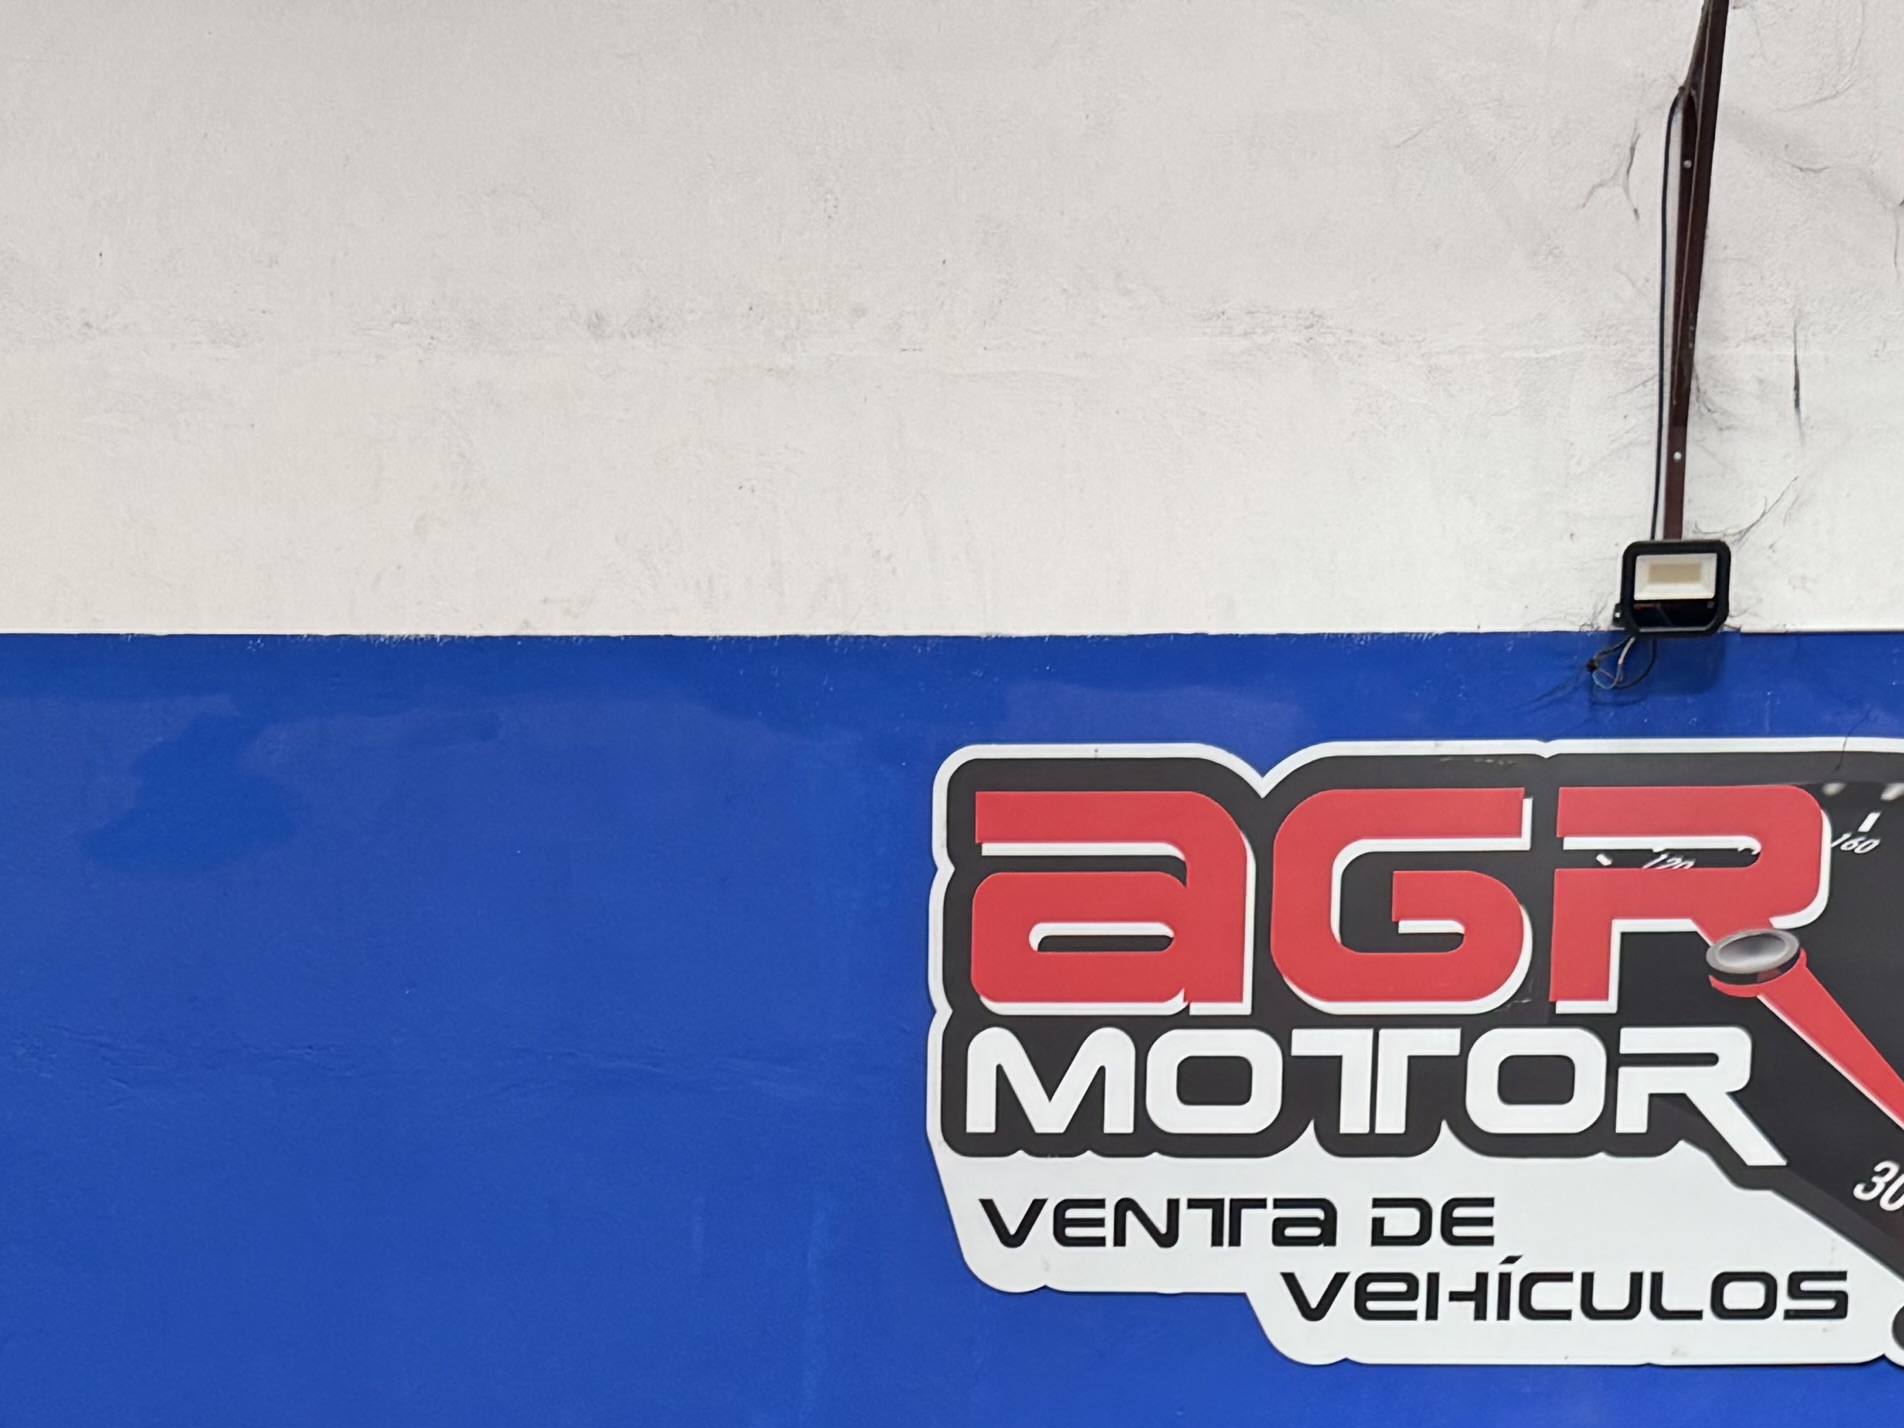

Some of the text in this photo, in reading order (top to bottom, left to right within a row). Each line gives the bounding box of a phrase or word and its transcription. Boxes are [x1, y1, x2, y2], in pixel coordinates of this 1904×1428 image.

[1830, 832, 1881, 855] 160
[965, 1026, 1788, 1167] MOTOR
[1370, 1197, 1496, 1248] DE
